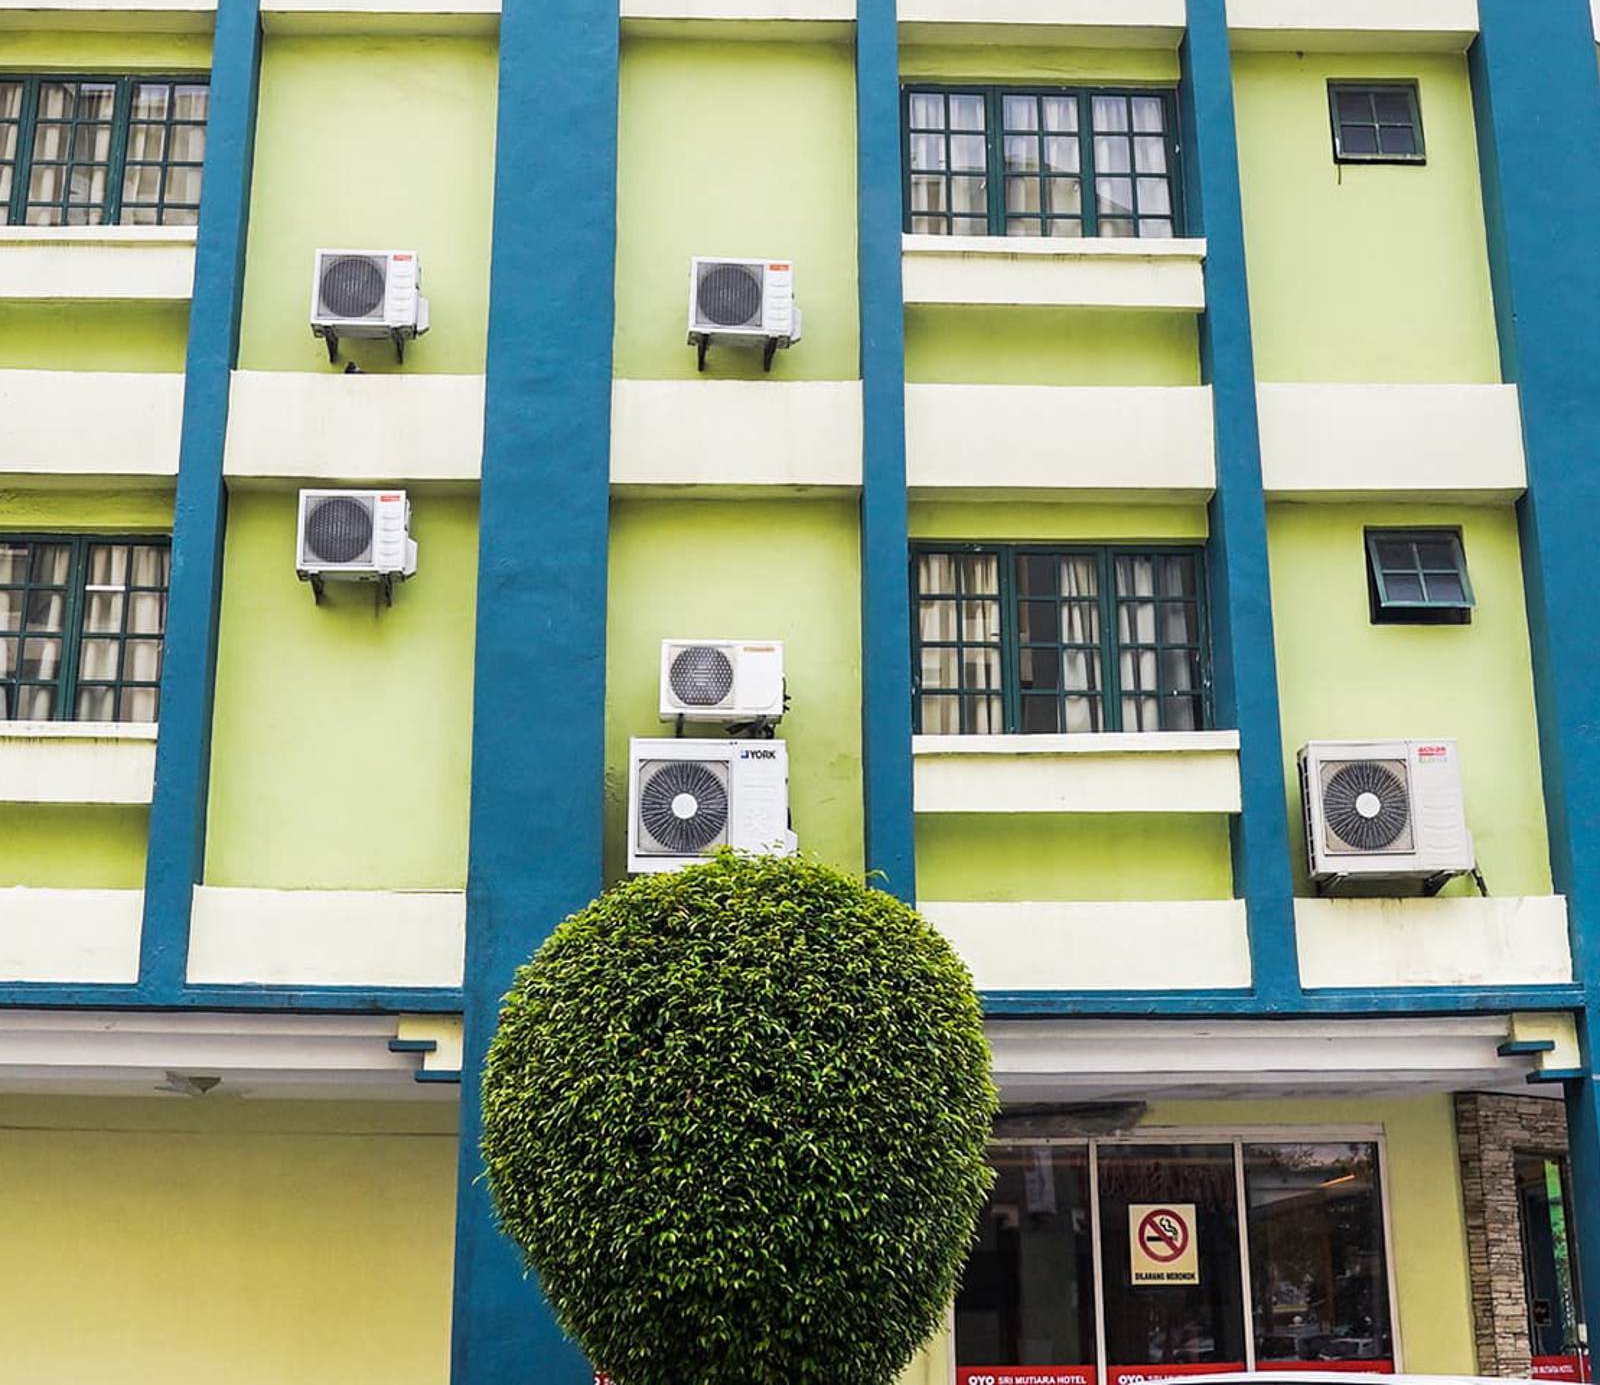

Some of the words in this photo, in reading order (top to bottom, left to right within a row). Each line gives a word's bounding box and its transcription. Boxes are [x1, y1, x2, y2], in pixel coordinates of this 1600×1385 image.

[750, 749, 776, 760] YORK
[968, 1375, 995, 1385] OYO
[998, 1376, 1013, 1384] SRI
[1015, 1376, 1055, 1384] MUTIARA
[1057, 1375, 1087, 1384] HOTEL
[1118, 1375, 1144, 1384] OYO
